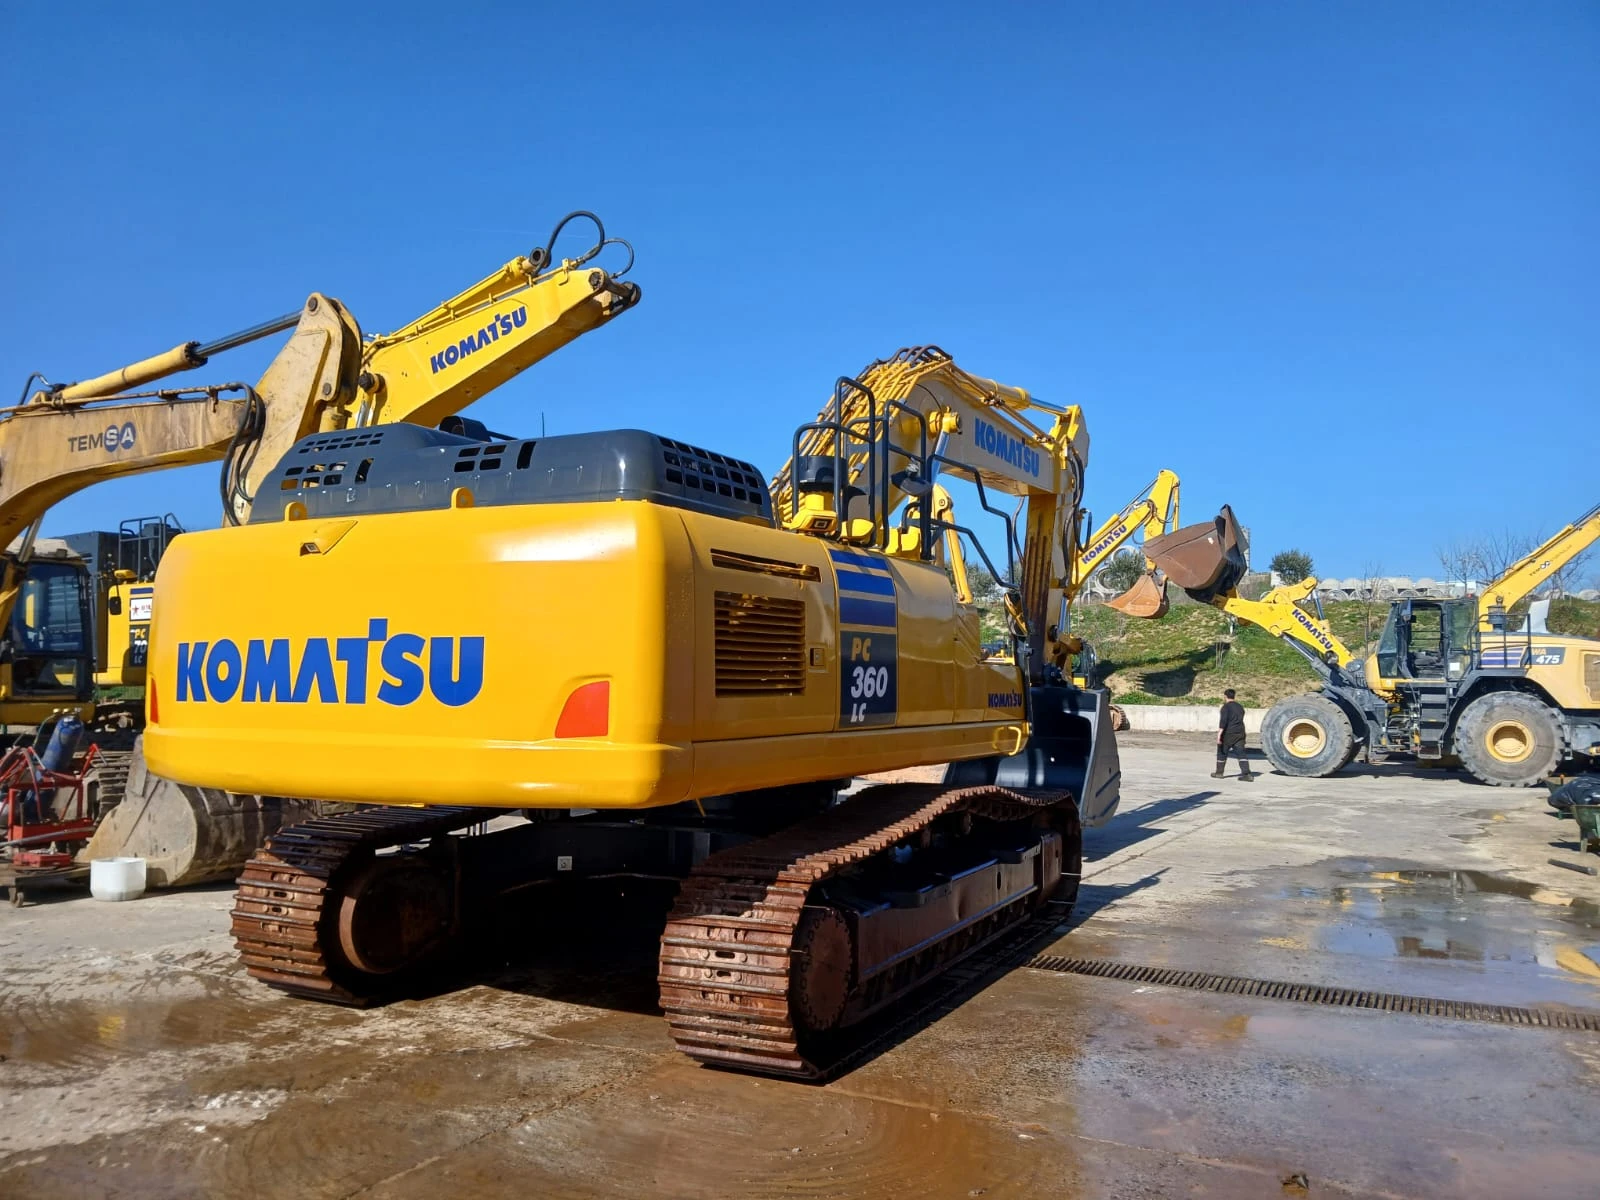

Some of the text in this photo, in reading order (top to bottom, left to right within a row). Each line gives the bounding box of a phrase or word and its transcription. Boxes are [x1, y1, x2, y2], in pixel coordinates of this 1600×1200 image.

[430, 306, 527, 374] KOMATSU
[68, 422, 136, 452] TEMSA
[975, 416, 1039, 478] KOMATSU
[1082, 525, 1127, 564] KOMATSU
[1292, 609, 1333, 649] KOMATSU
[176, 618, 485, 706] KOMATSU
[851, 637, 872, 662] PC
[1536, 655, 1561, 664] 475
[850, 666, 888, 698] 360
[988, 689, 1023, 707] KOMATSU
[850, 703, 867, 723] LC
